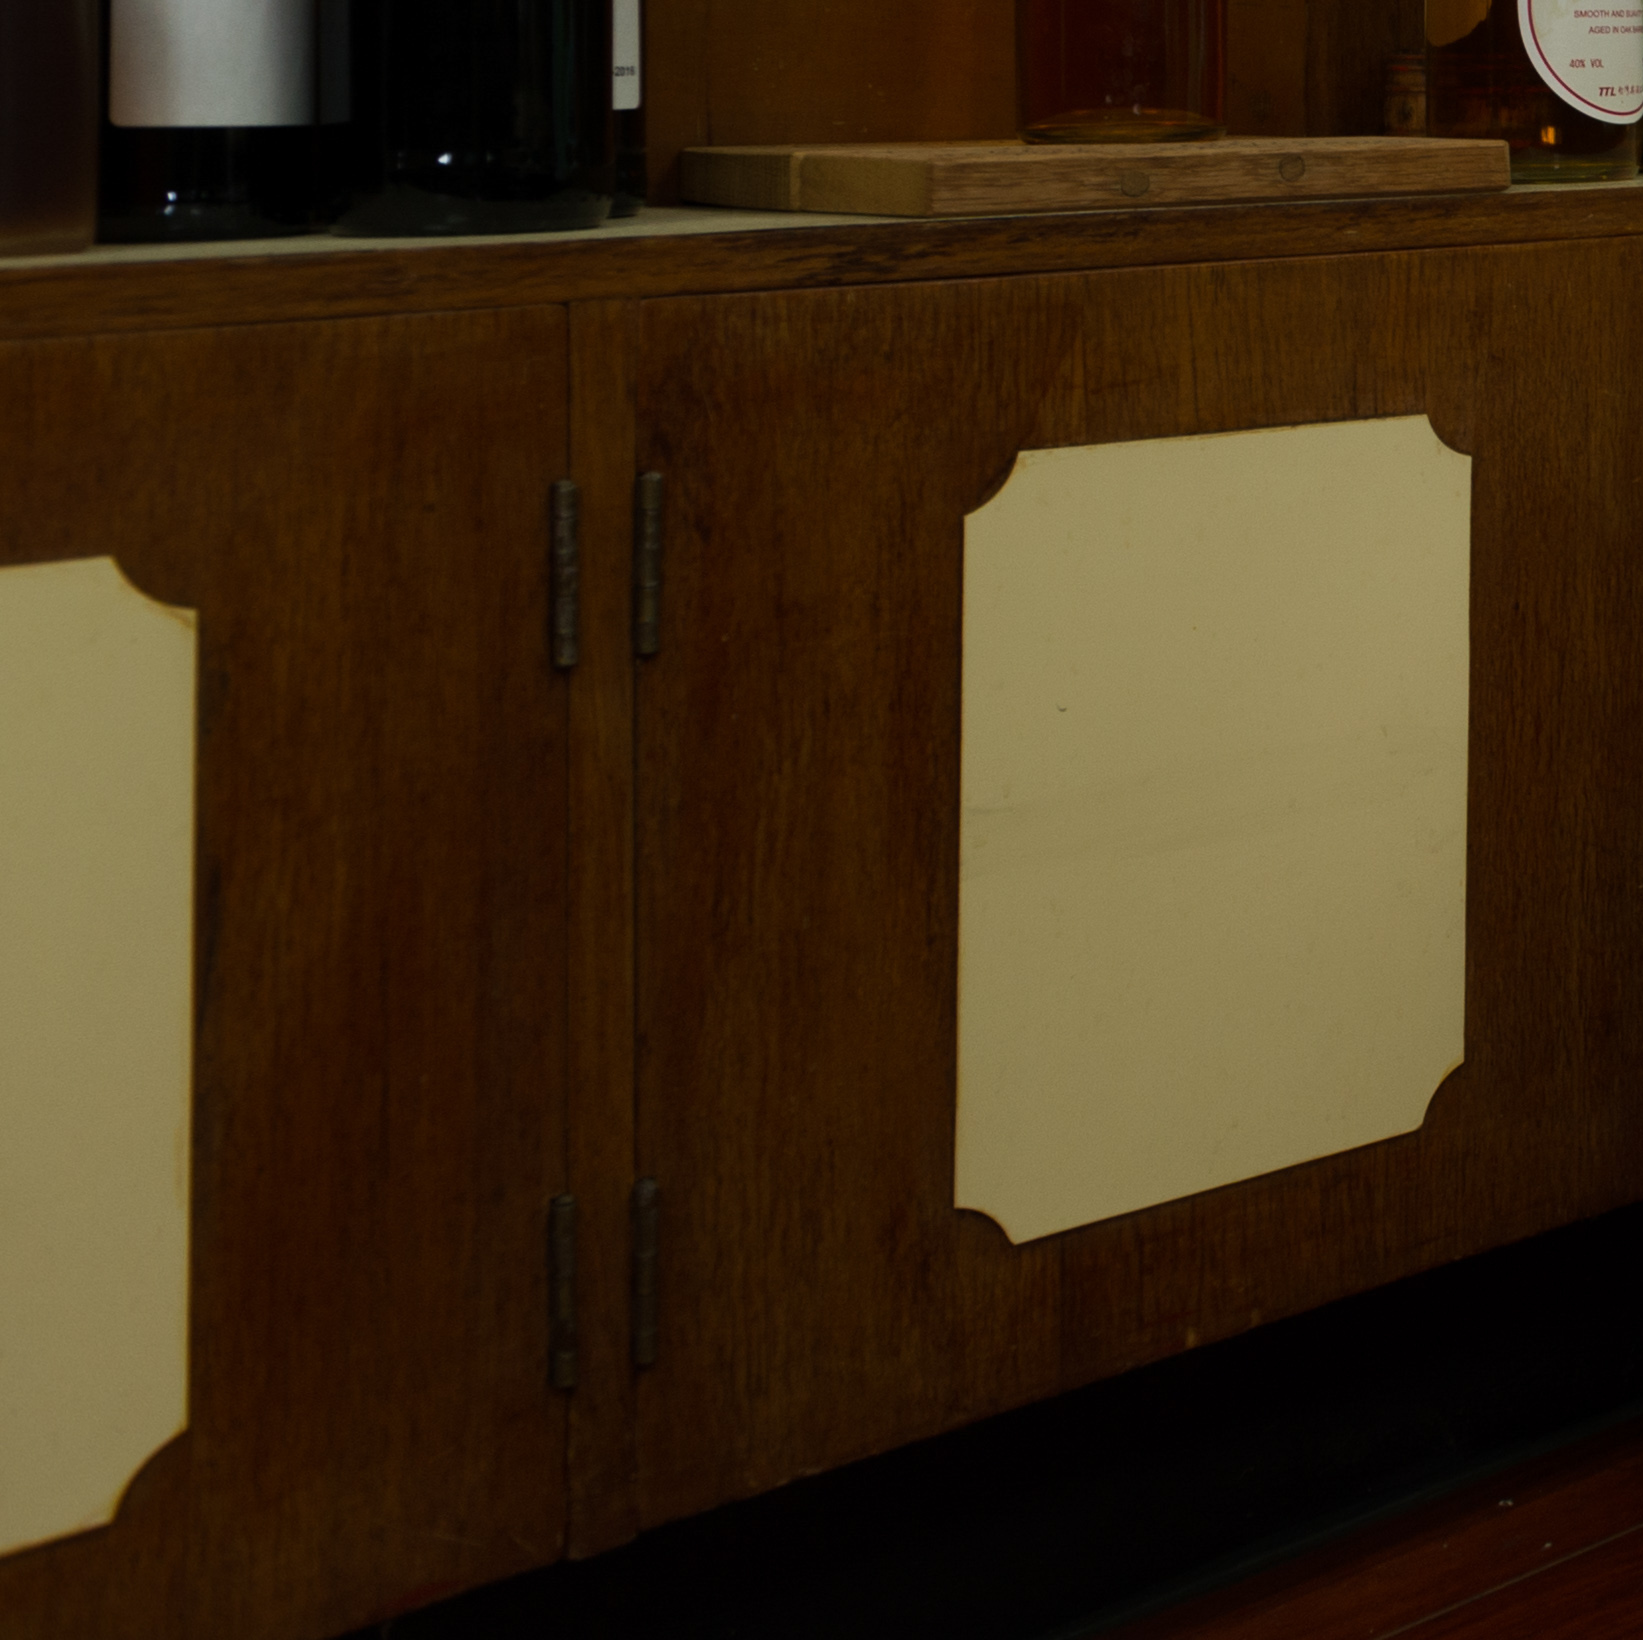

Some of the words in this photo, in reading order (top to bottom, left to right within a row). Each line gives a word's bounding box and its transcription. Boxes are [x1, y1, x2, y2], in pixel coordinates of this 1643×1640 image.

[1573, 9, 1610, 18] SMOOTH
[1611, 9, 1624, 18] AND
[1588, 25, 1611, 34] AGED
[1612, 25, 1619, 34] IN
[1569, 58, 1586, 68] 40%
[1590, 58, 1604, 68] VOL
[1599, 86, 1617, 97] TTL
